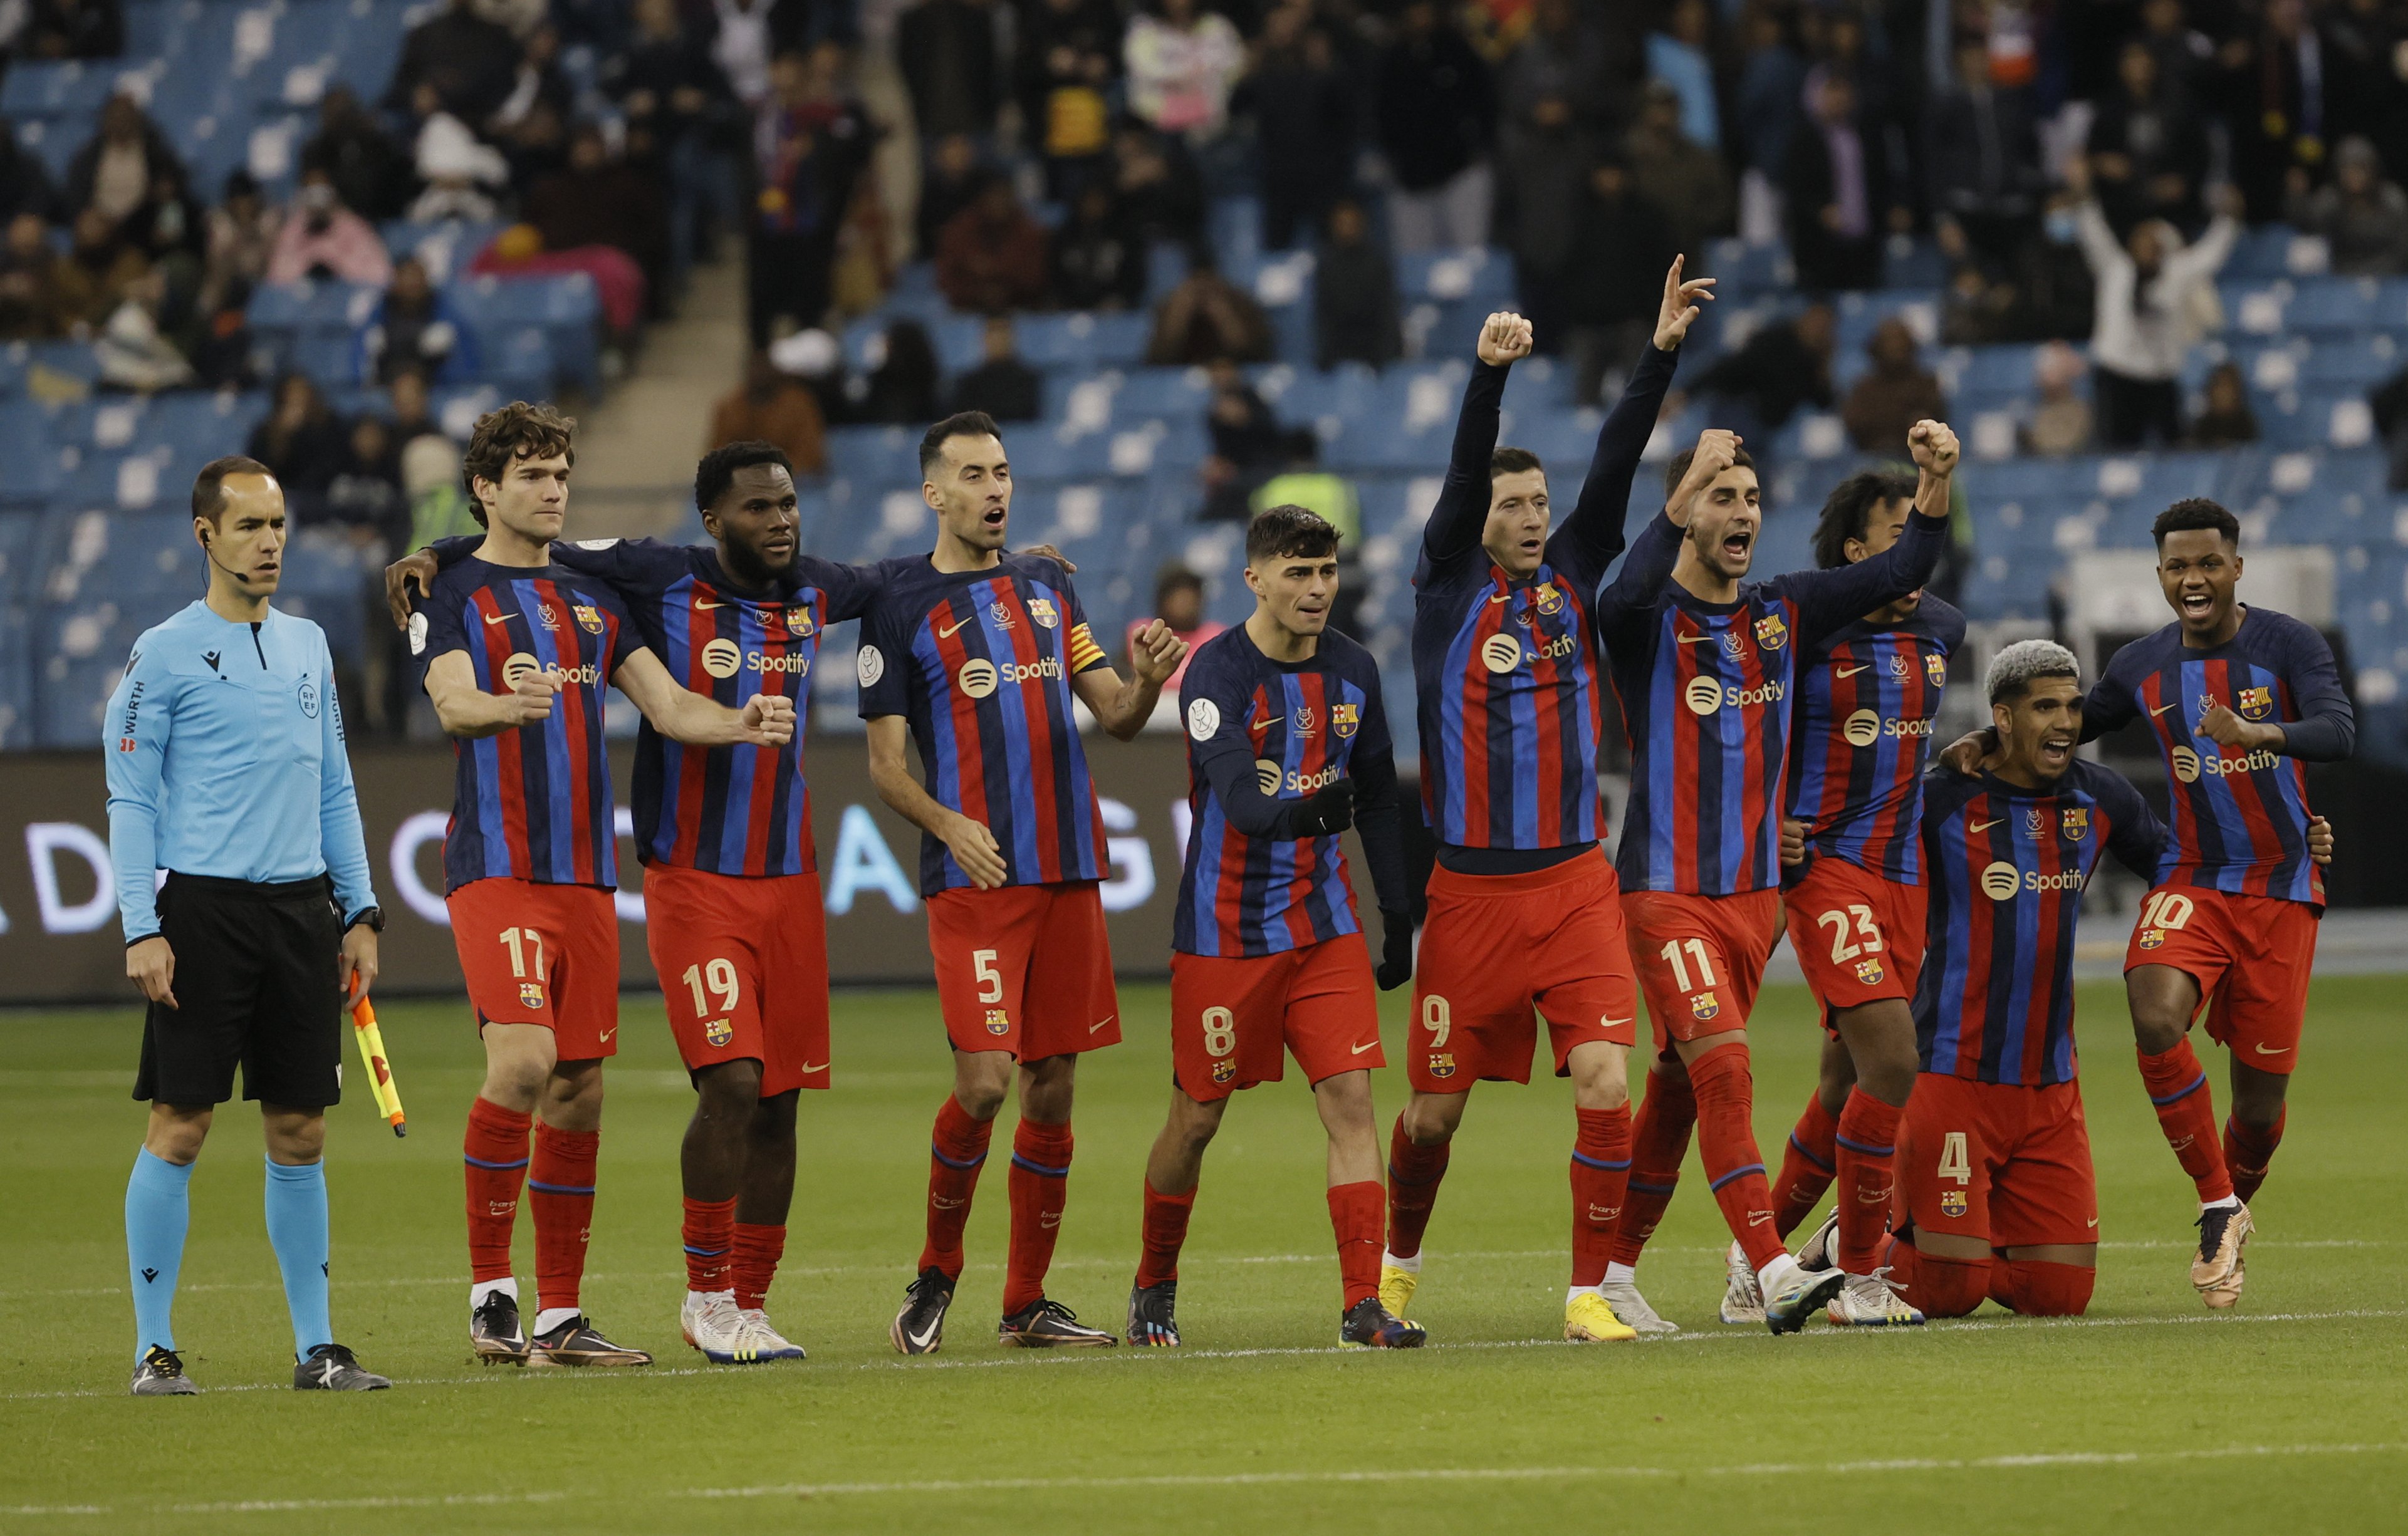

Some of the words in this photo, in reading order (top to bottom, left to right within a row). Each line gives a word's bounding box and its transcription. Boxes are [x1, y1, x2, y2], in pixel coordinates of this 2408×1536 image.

[747, 651, 810, 677] Spotify
[1001, 656, 1063, 684] Spotify
[124, 681, 145, 734] WÜRTH
[1726, 680, 1785, 709] Spotiy
[2205, 750, 2280, 777] Spotify
[2025, 869, 2087, 893] Spotify
[1818, 905, 1882, 965] 23
[2139, 891, 2194, 930] 10
[499, 926, 545, 981] 17
[972, 950, 1003, 1003] 5
[1660, 938, 1716, 993] 11
[682, 958, 739, 1018] 19
[1202, 1006, 1236, 1057] 8
[1422, 995, 1450, 1047] 9
[1938, 1132, 1971, 1185] 4
